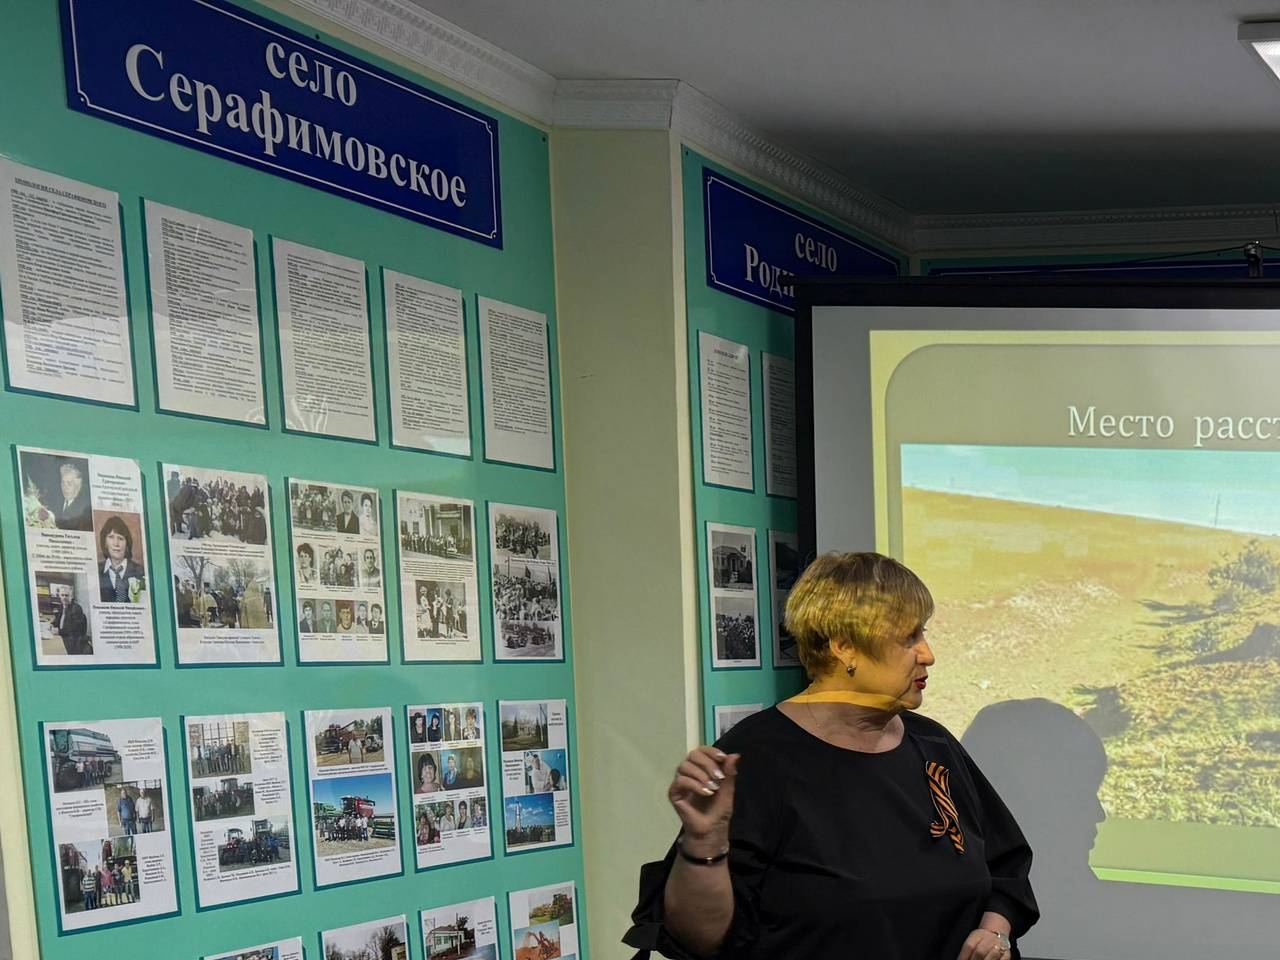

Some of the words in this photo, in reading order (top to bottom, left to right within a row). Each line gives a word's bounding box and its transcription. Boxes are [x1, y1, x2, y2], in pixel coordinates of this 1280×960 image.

[265, 42, 357, 107] село
[125, 43, 467, 208] Серафимовское
[794, 232, 838, 272] село
[1067, 405, 1175, 438] Место
